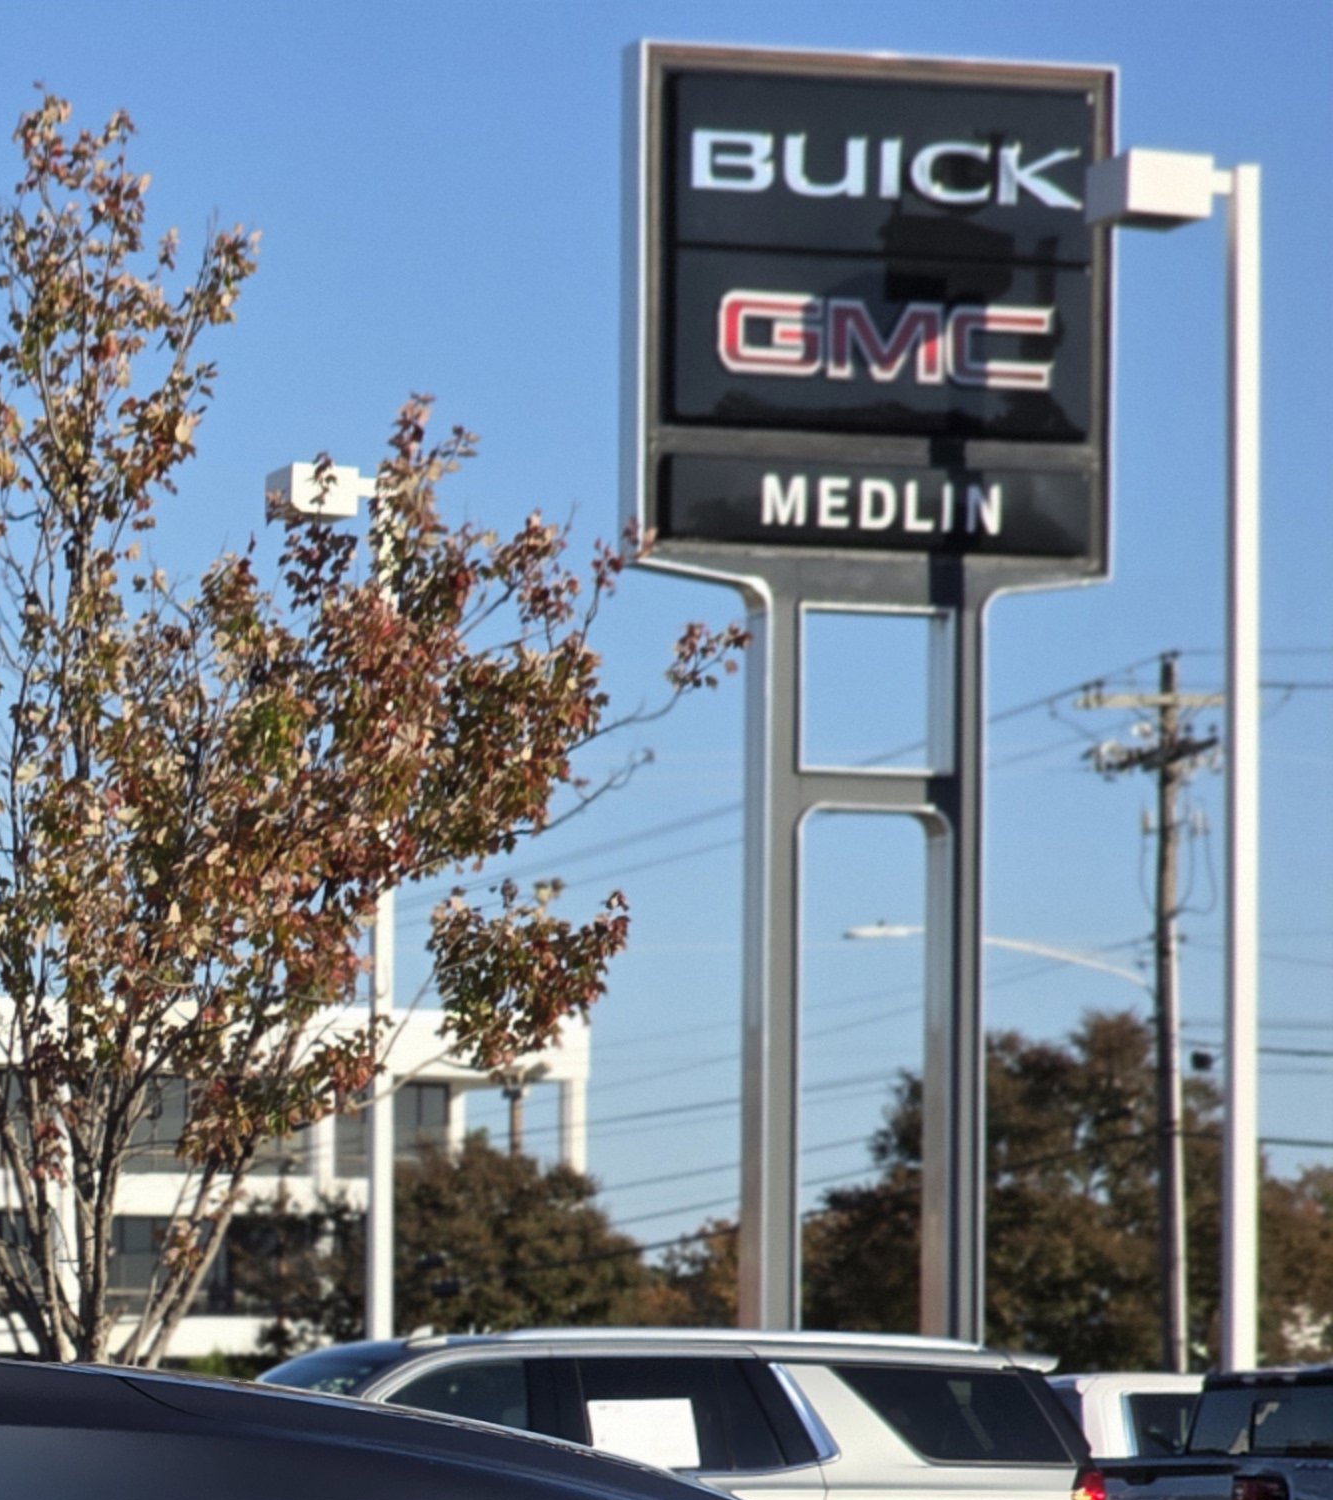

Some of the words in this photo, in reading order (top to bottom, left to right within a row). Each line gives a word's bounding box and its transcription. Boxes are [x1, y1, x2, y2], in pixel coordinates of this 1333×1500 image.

[690, 128, 1082, 211] BUICK
[717, 288, 1055, 391] GMC
[760, 473, 1001, 536] MEDLIN
